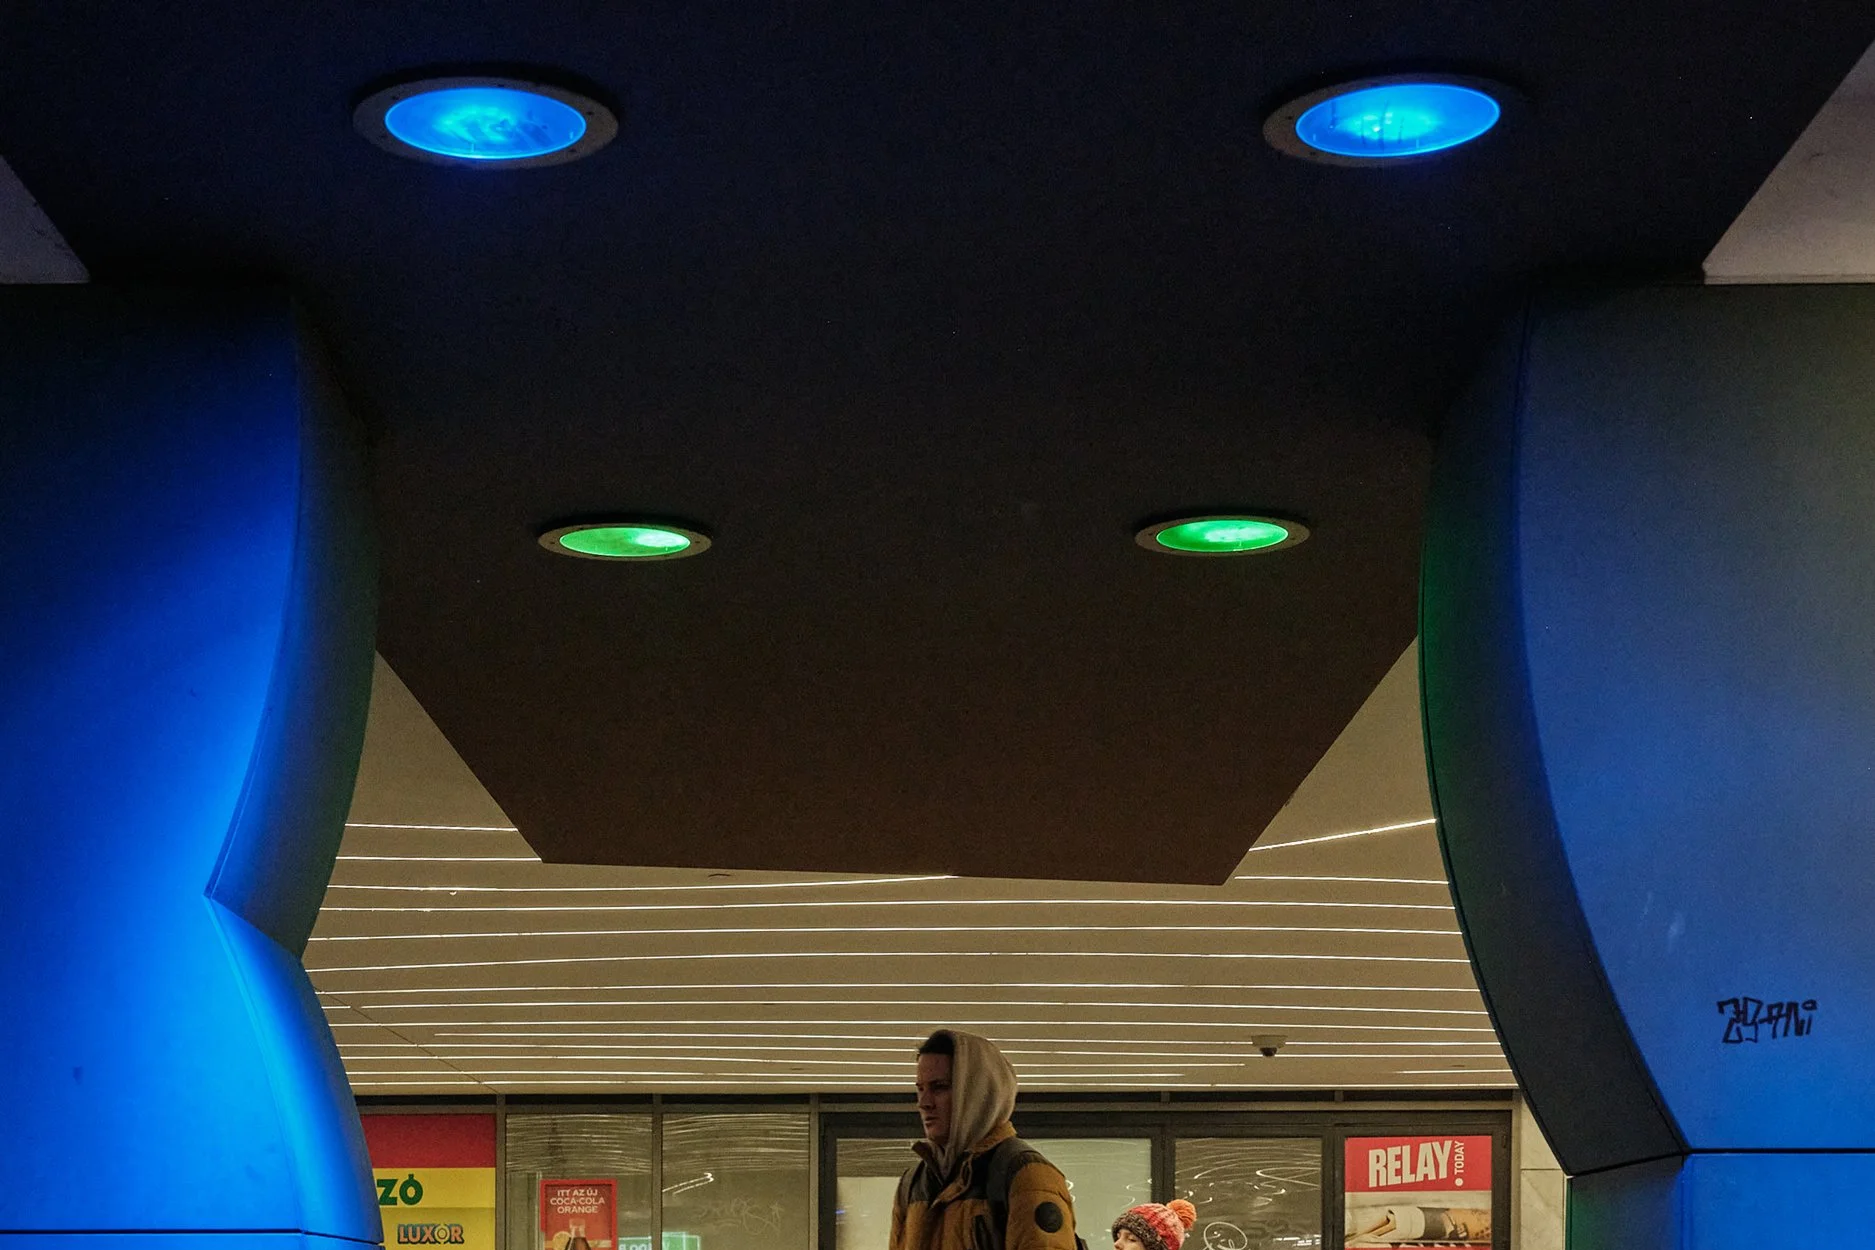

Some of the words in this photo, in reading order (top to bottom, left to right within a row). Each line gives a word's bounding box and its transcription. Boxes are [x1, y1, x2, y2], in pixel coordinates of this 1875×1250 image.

[1369, 1140, 1452, 1188] RELAY
[1454, 1141, 1465, 1175] TODAY
[586, 1187, 598, 1196] ÚJ
[557, 1206, 599, 1214] ORANGE
[398, 1223, 465, 1244] LUXOR
